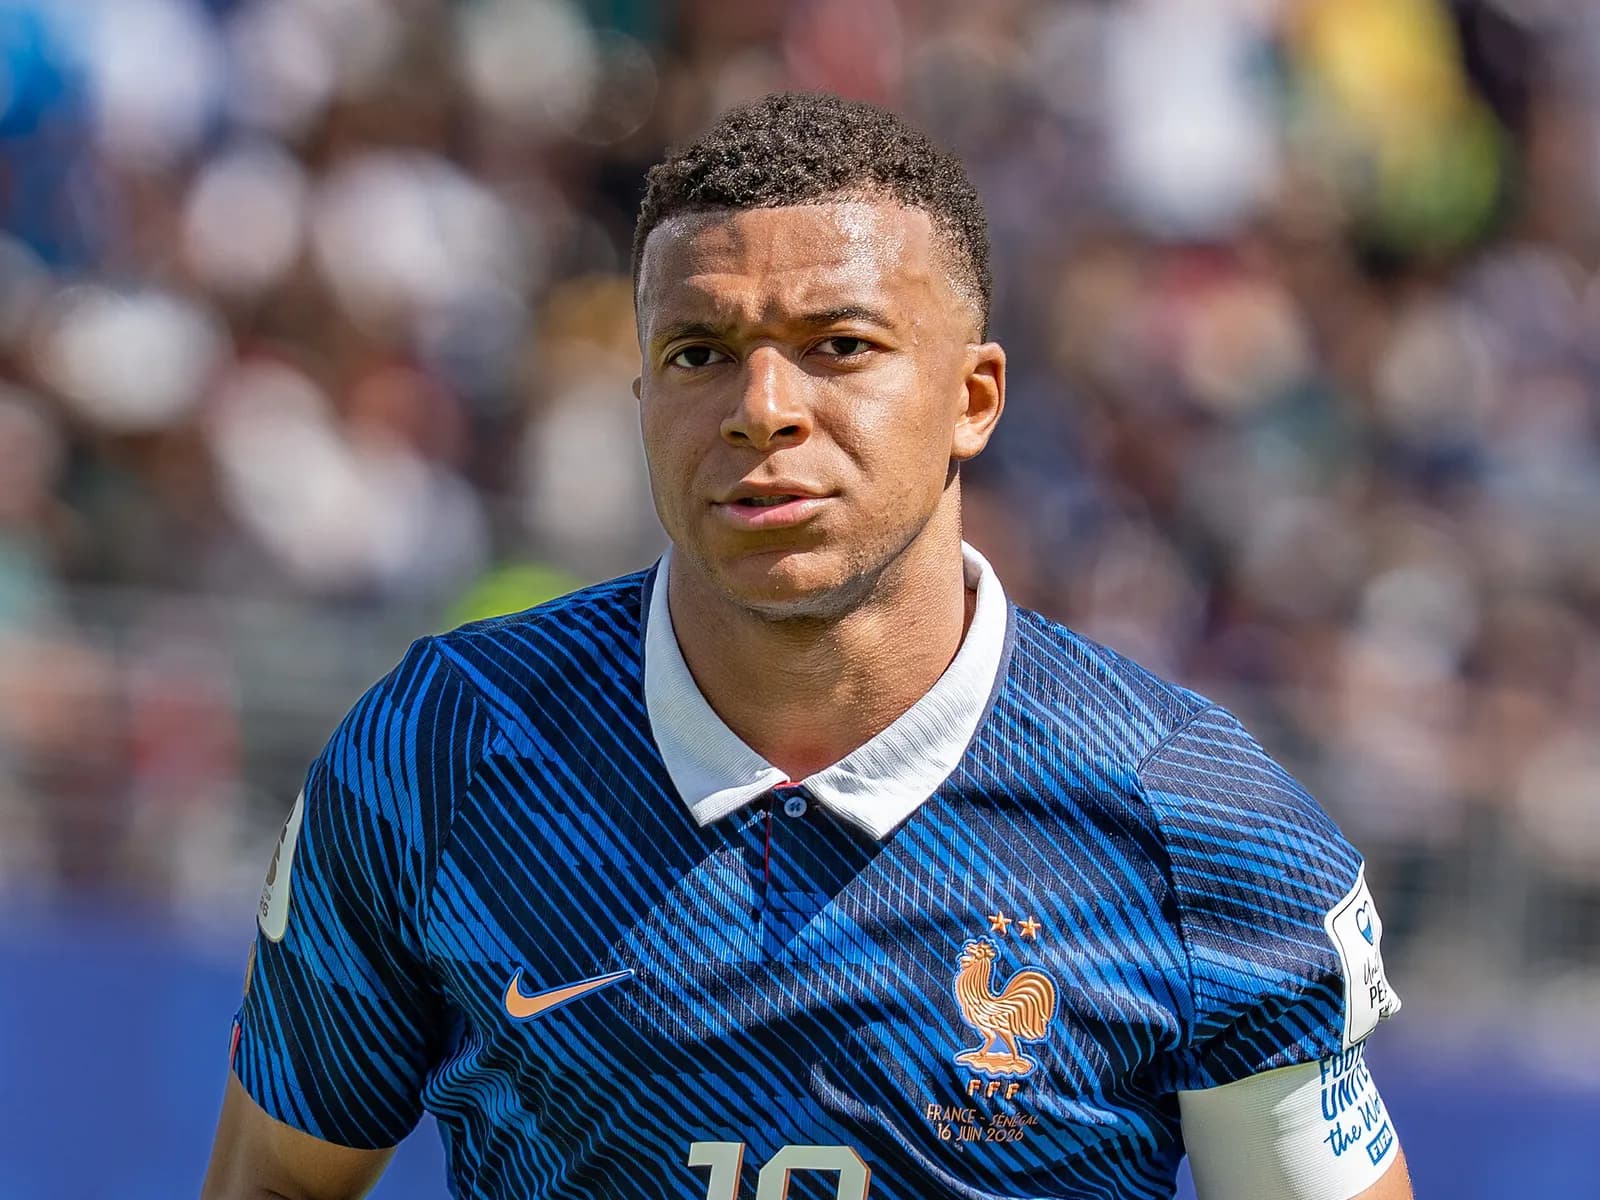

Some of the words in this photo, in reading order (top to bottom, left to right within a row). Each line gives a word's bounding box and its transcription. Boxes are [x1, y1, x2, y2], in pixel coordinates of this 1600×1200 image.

[967, 1079, 1020, 1100] FFF
[926, 1103, 977, 1123] FRANCE
[988, 1111, 1039, 1128] SÉNÉGAL
[937, 1122, 952, 1141] 16
[955, 1124, 983, 1143] JUIN
[984, 1126, 1024, 1143] 2026
[1323, 1121, 1362, 1157] the
